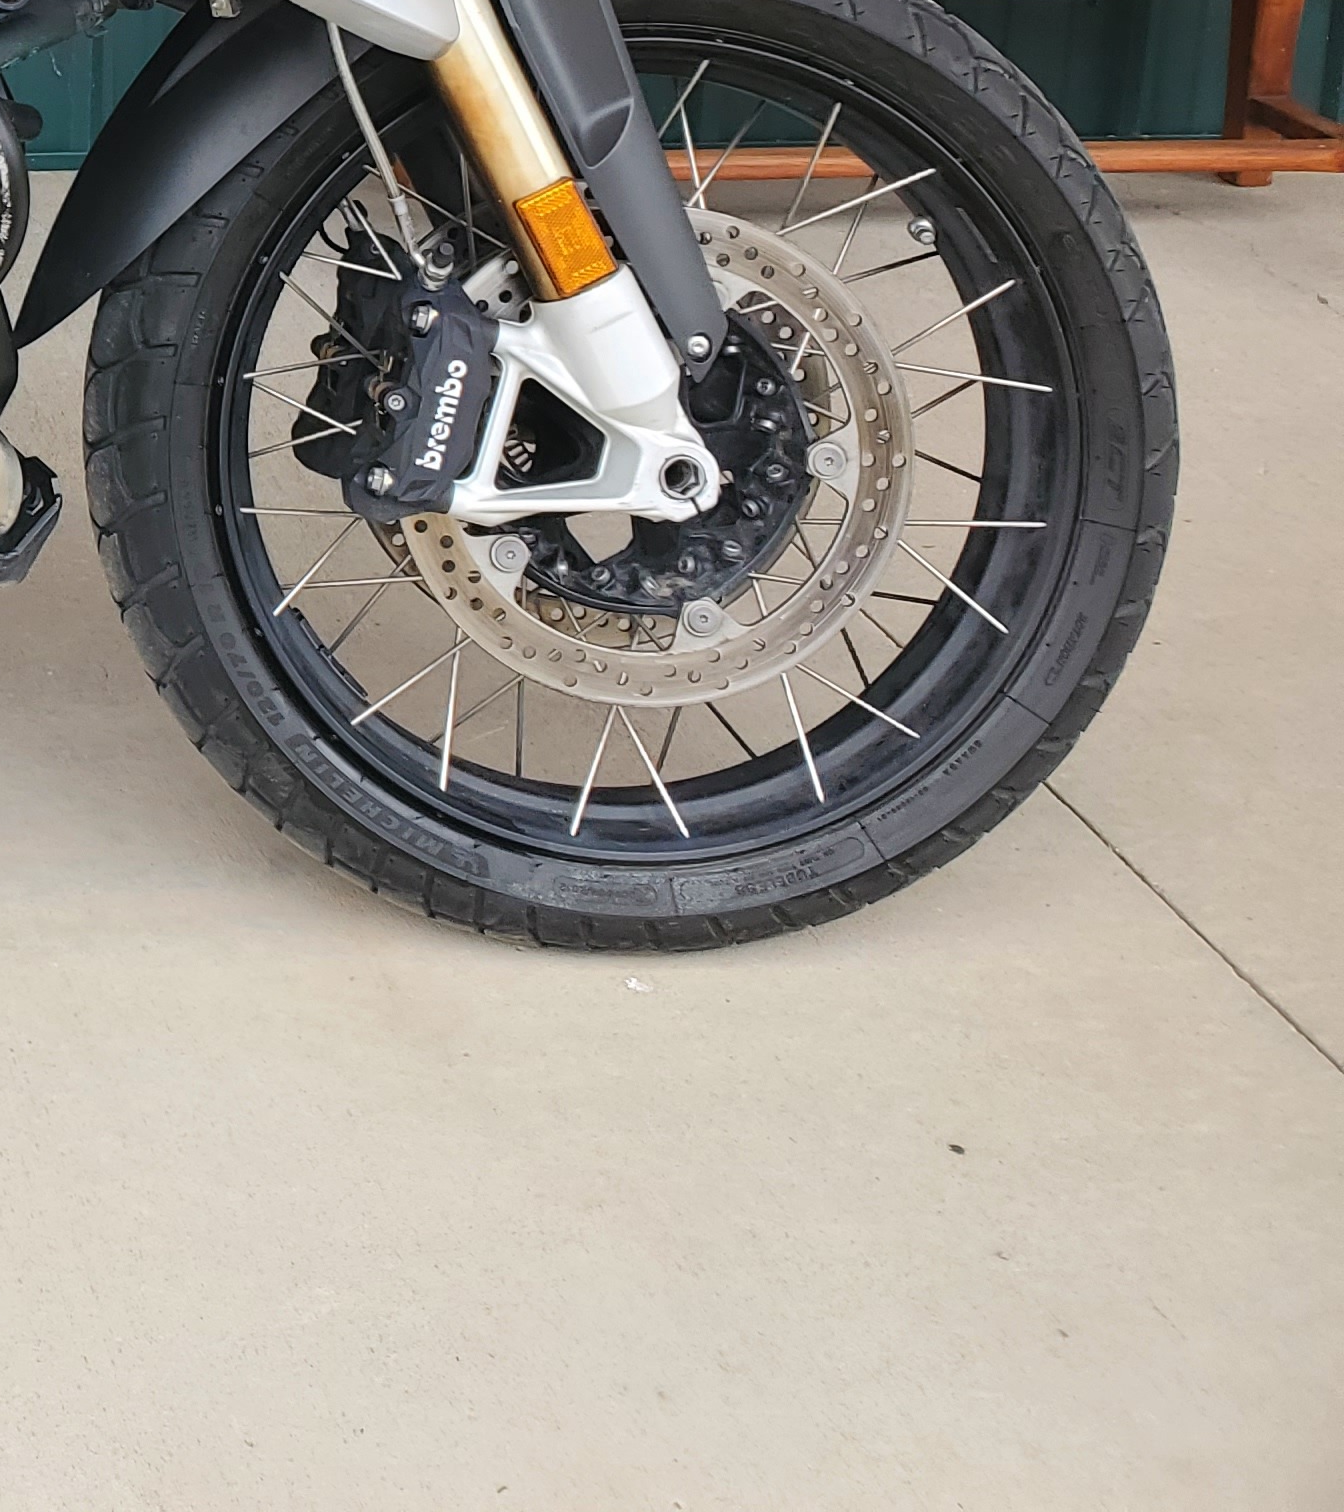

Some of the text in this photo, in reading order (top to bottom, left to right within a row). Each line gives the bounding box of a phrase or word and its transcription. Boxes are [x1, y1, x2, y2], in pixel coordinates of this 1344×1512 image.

[414, 359, 468, 471] brembo
[292, 742, 445, 855] MICHELIN
[734, 865, 816, 898] TUBELESS
